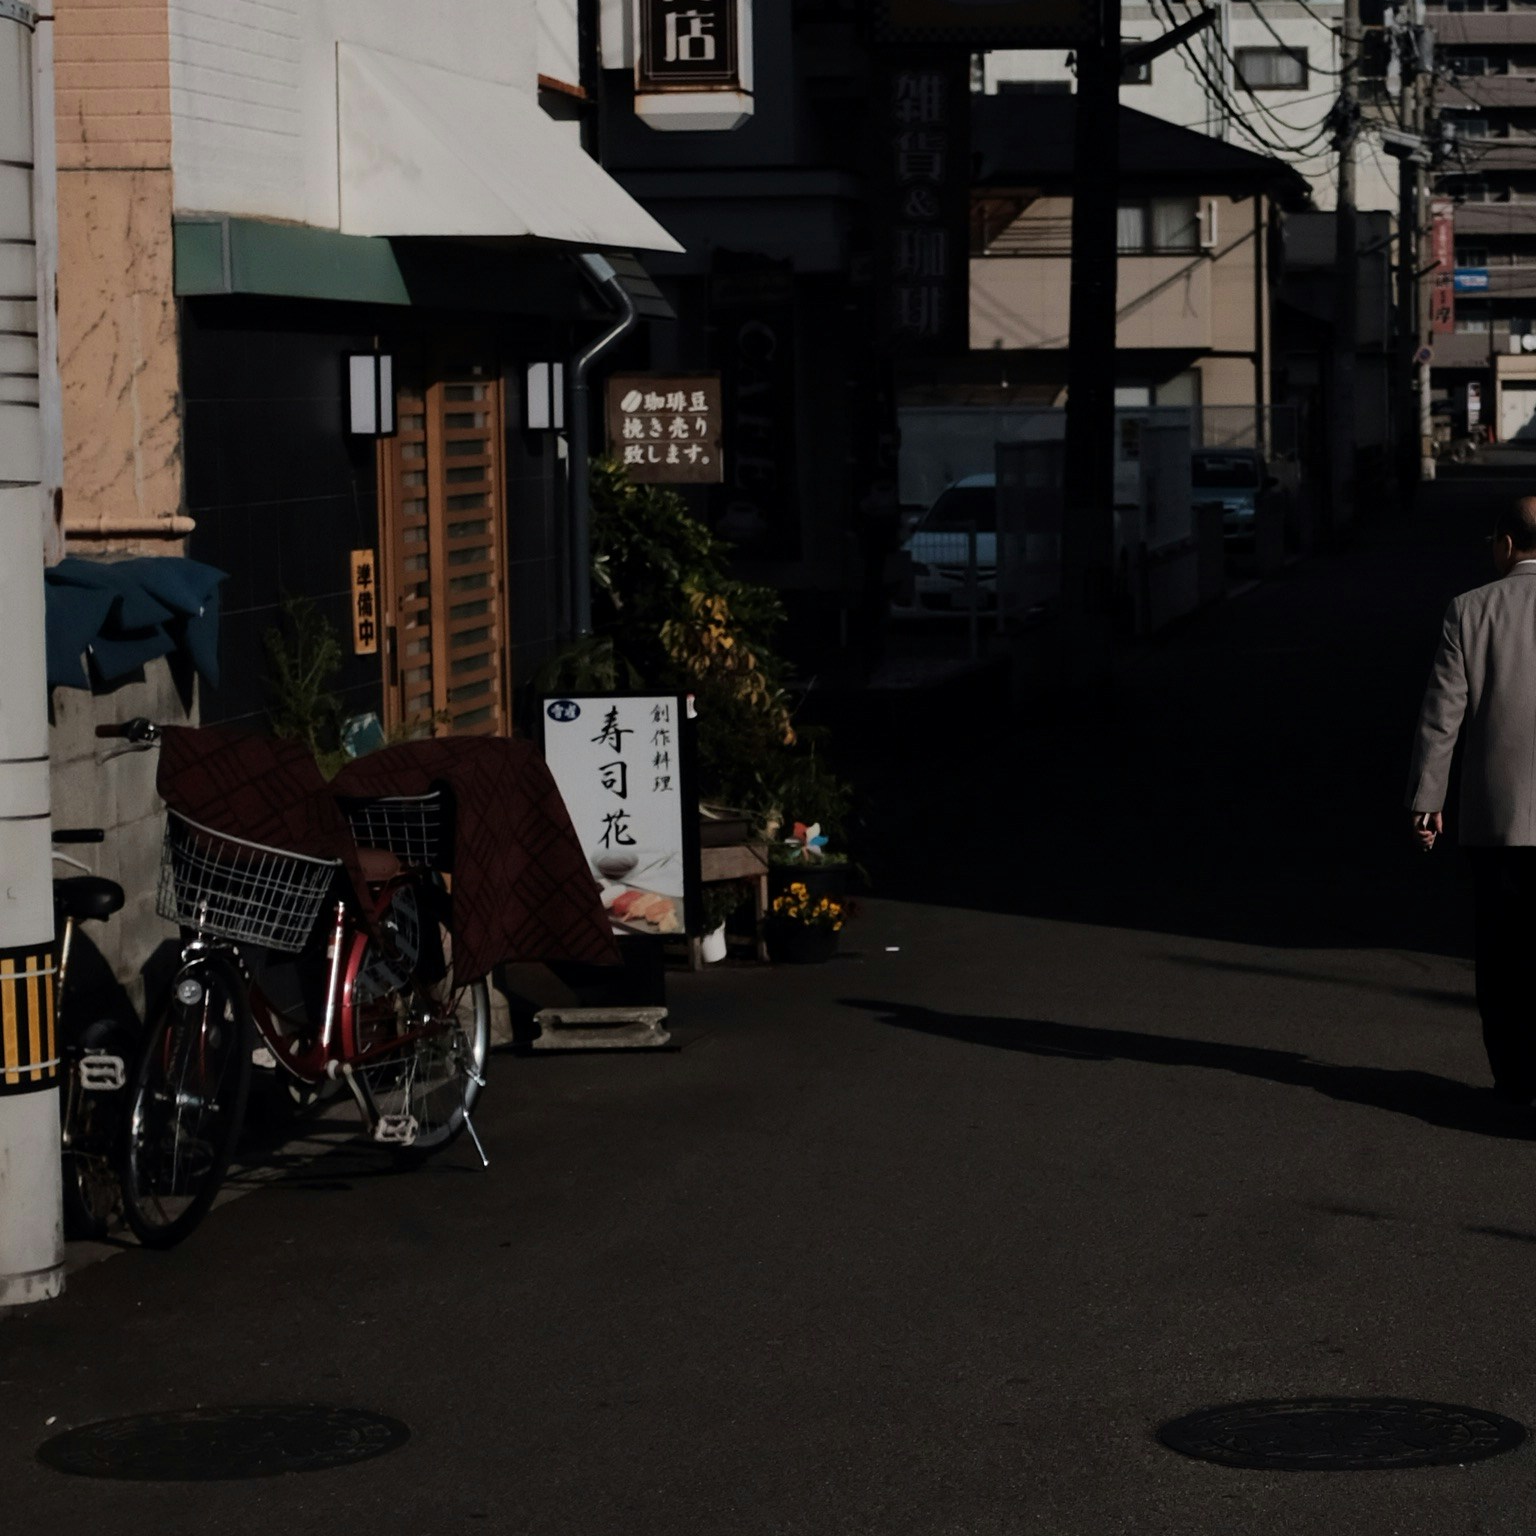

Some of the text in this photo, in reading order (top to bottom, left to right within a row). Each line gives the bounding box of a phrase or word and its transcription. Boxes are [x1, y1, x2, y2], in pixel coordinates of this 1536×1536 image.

[622, 416, 708, 440] 挽き売り
[643, 390, 710, 413] 珈琲豆
[623, 443, 711, 465] 致します。
[357, 563, 374, 647] 準備中
[651, 703, 673, 794] 創作料理
[590, 705, 637, 850] 寿司花
